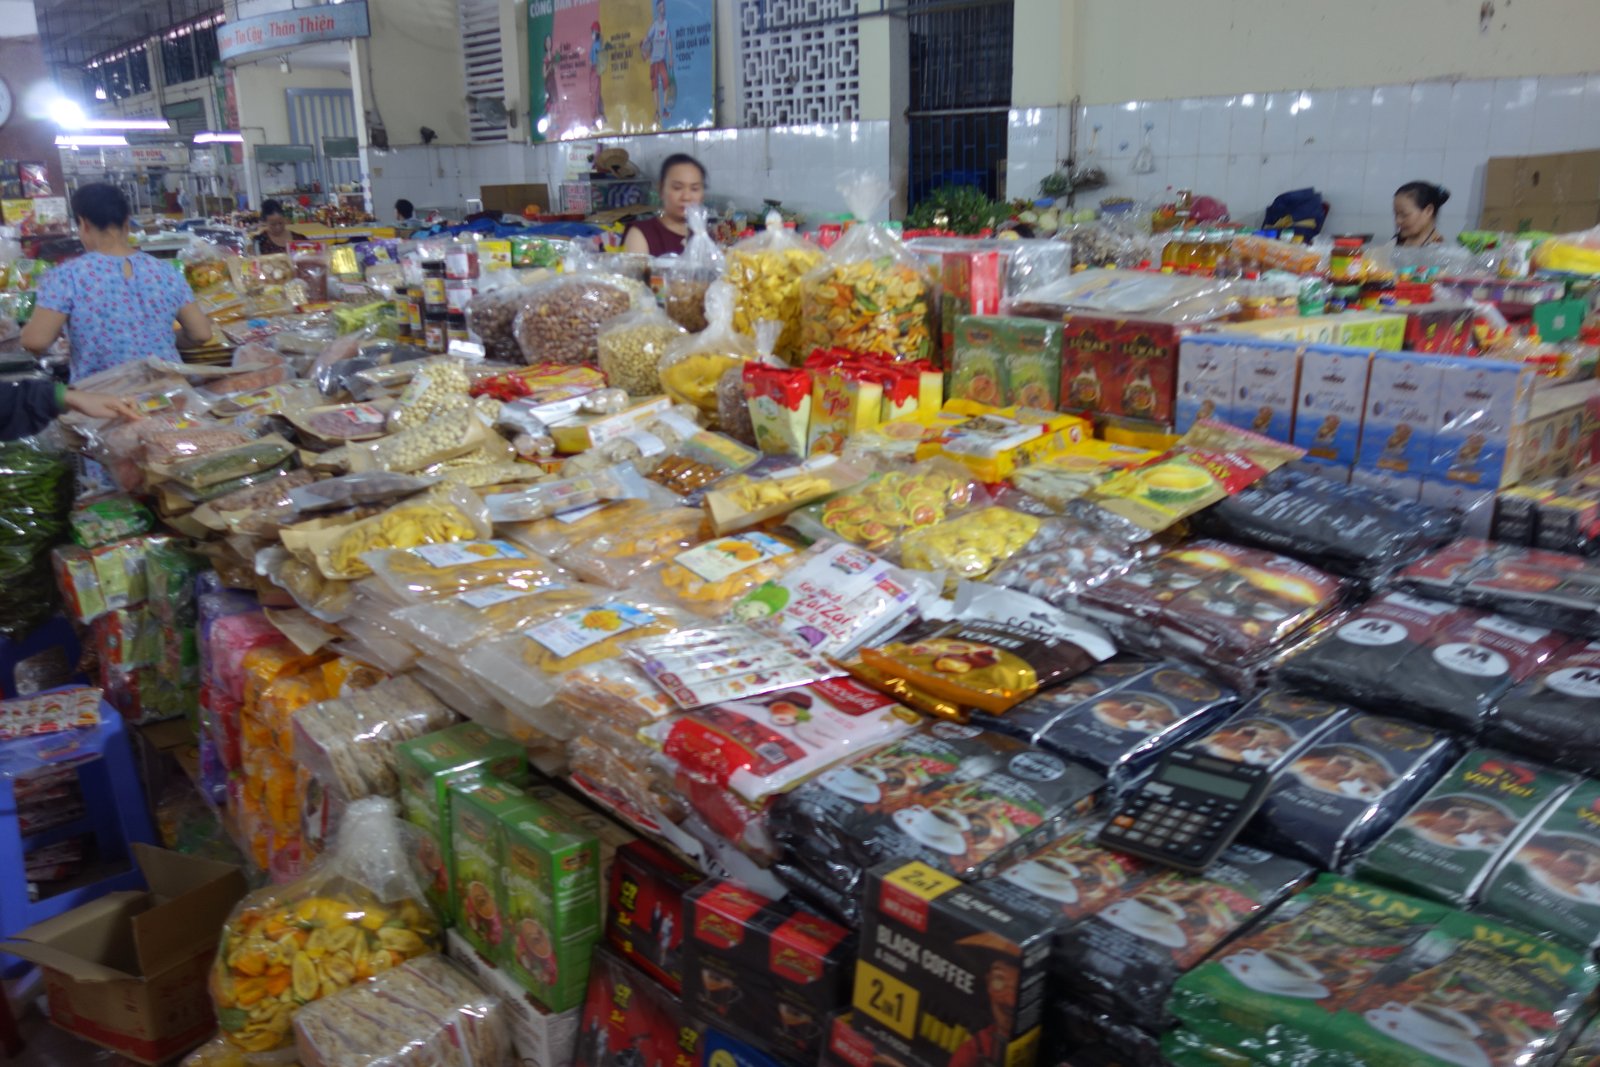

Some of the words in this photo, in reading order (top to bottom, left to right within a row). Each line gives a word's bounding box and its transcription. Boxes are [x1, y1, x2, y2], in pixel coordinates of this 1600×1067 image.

[300, 14, 335, 37] Thiện
[876, 924, 921, 963] BLACK
[921, 949, 976, 994] COFFEE
